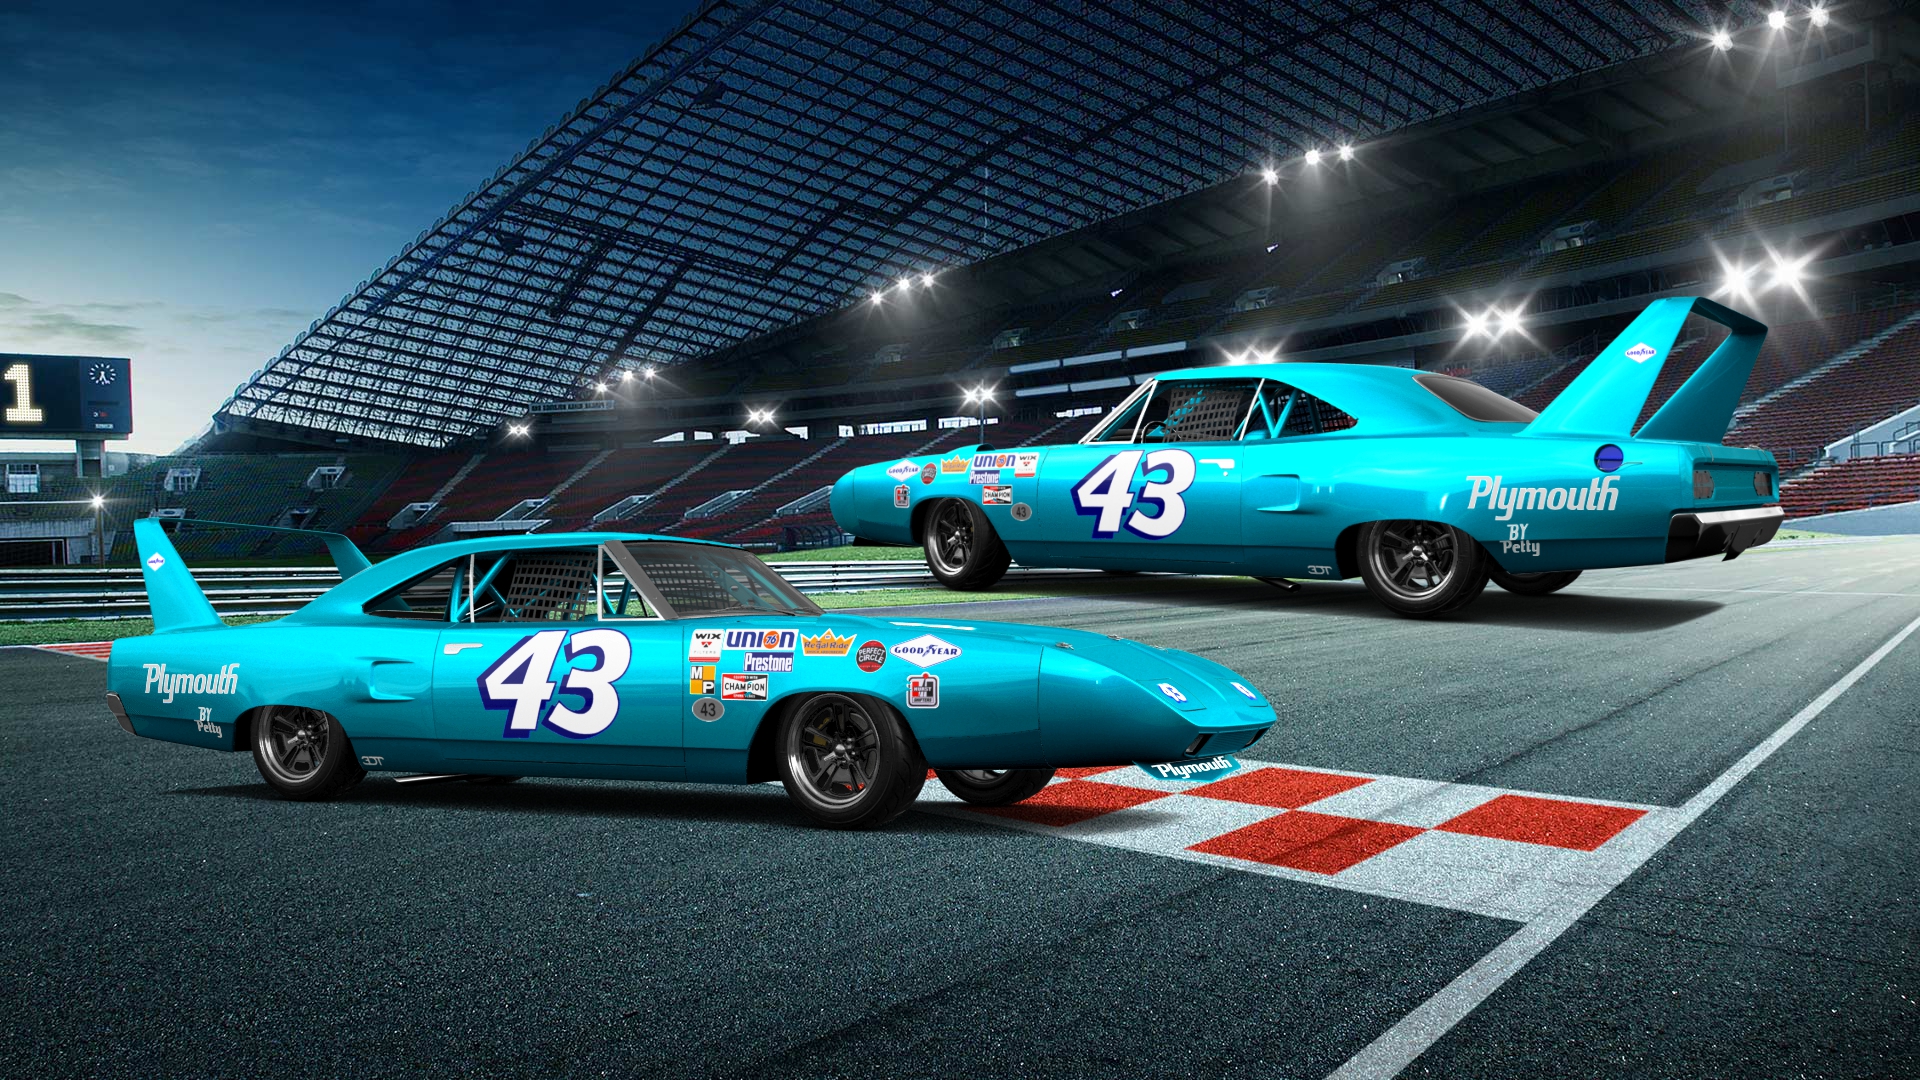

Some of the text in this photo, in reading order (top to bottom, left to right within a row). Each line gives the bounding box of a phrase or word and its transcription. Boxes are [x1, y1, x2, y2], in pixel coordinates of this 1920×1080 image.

[4, 364, 43, 421] 1
[973, 454, 1016, 468] UNION
[970, 471, 999, 484] Prestone
[984, 491, 1011, 499] CHAMPION
[1070, 448, 1196, 541] 43
[1466, 475, 1621, 521] Plymouth
[1016, 506, 1027, 517] 43
[1507, 523, 1529, 541] BY
[1499, 540, 1541, 557] Petty
[726, 631, 795, 648] UNION
[766, 635, 777, 644] 76
[858, 647, 886, 657] PERFECT
[858, 654, 885, 664] CIRCLE
[744, 652, 793, 672] Prestone
[142, 663, 240, 703] Plymouth
[476, 627, 632, 740] 43
[724, 682, 765, 692] CHAMPION
[198, 706, 212, 722] BY
[700, 702, 716, 717] 43
[194, 719, 222, 739] Petty
[1151, 755, 1233, 779] Plymouth
